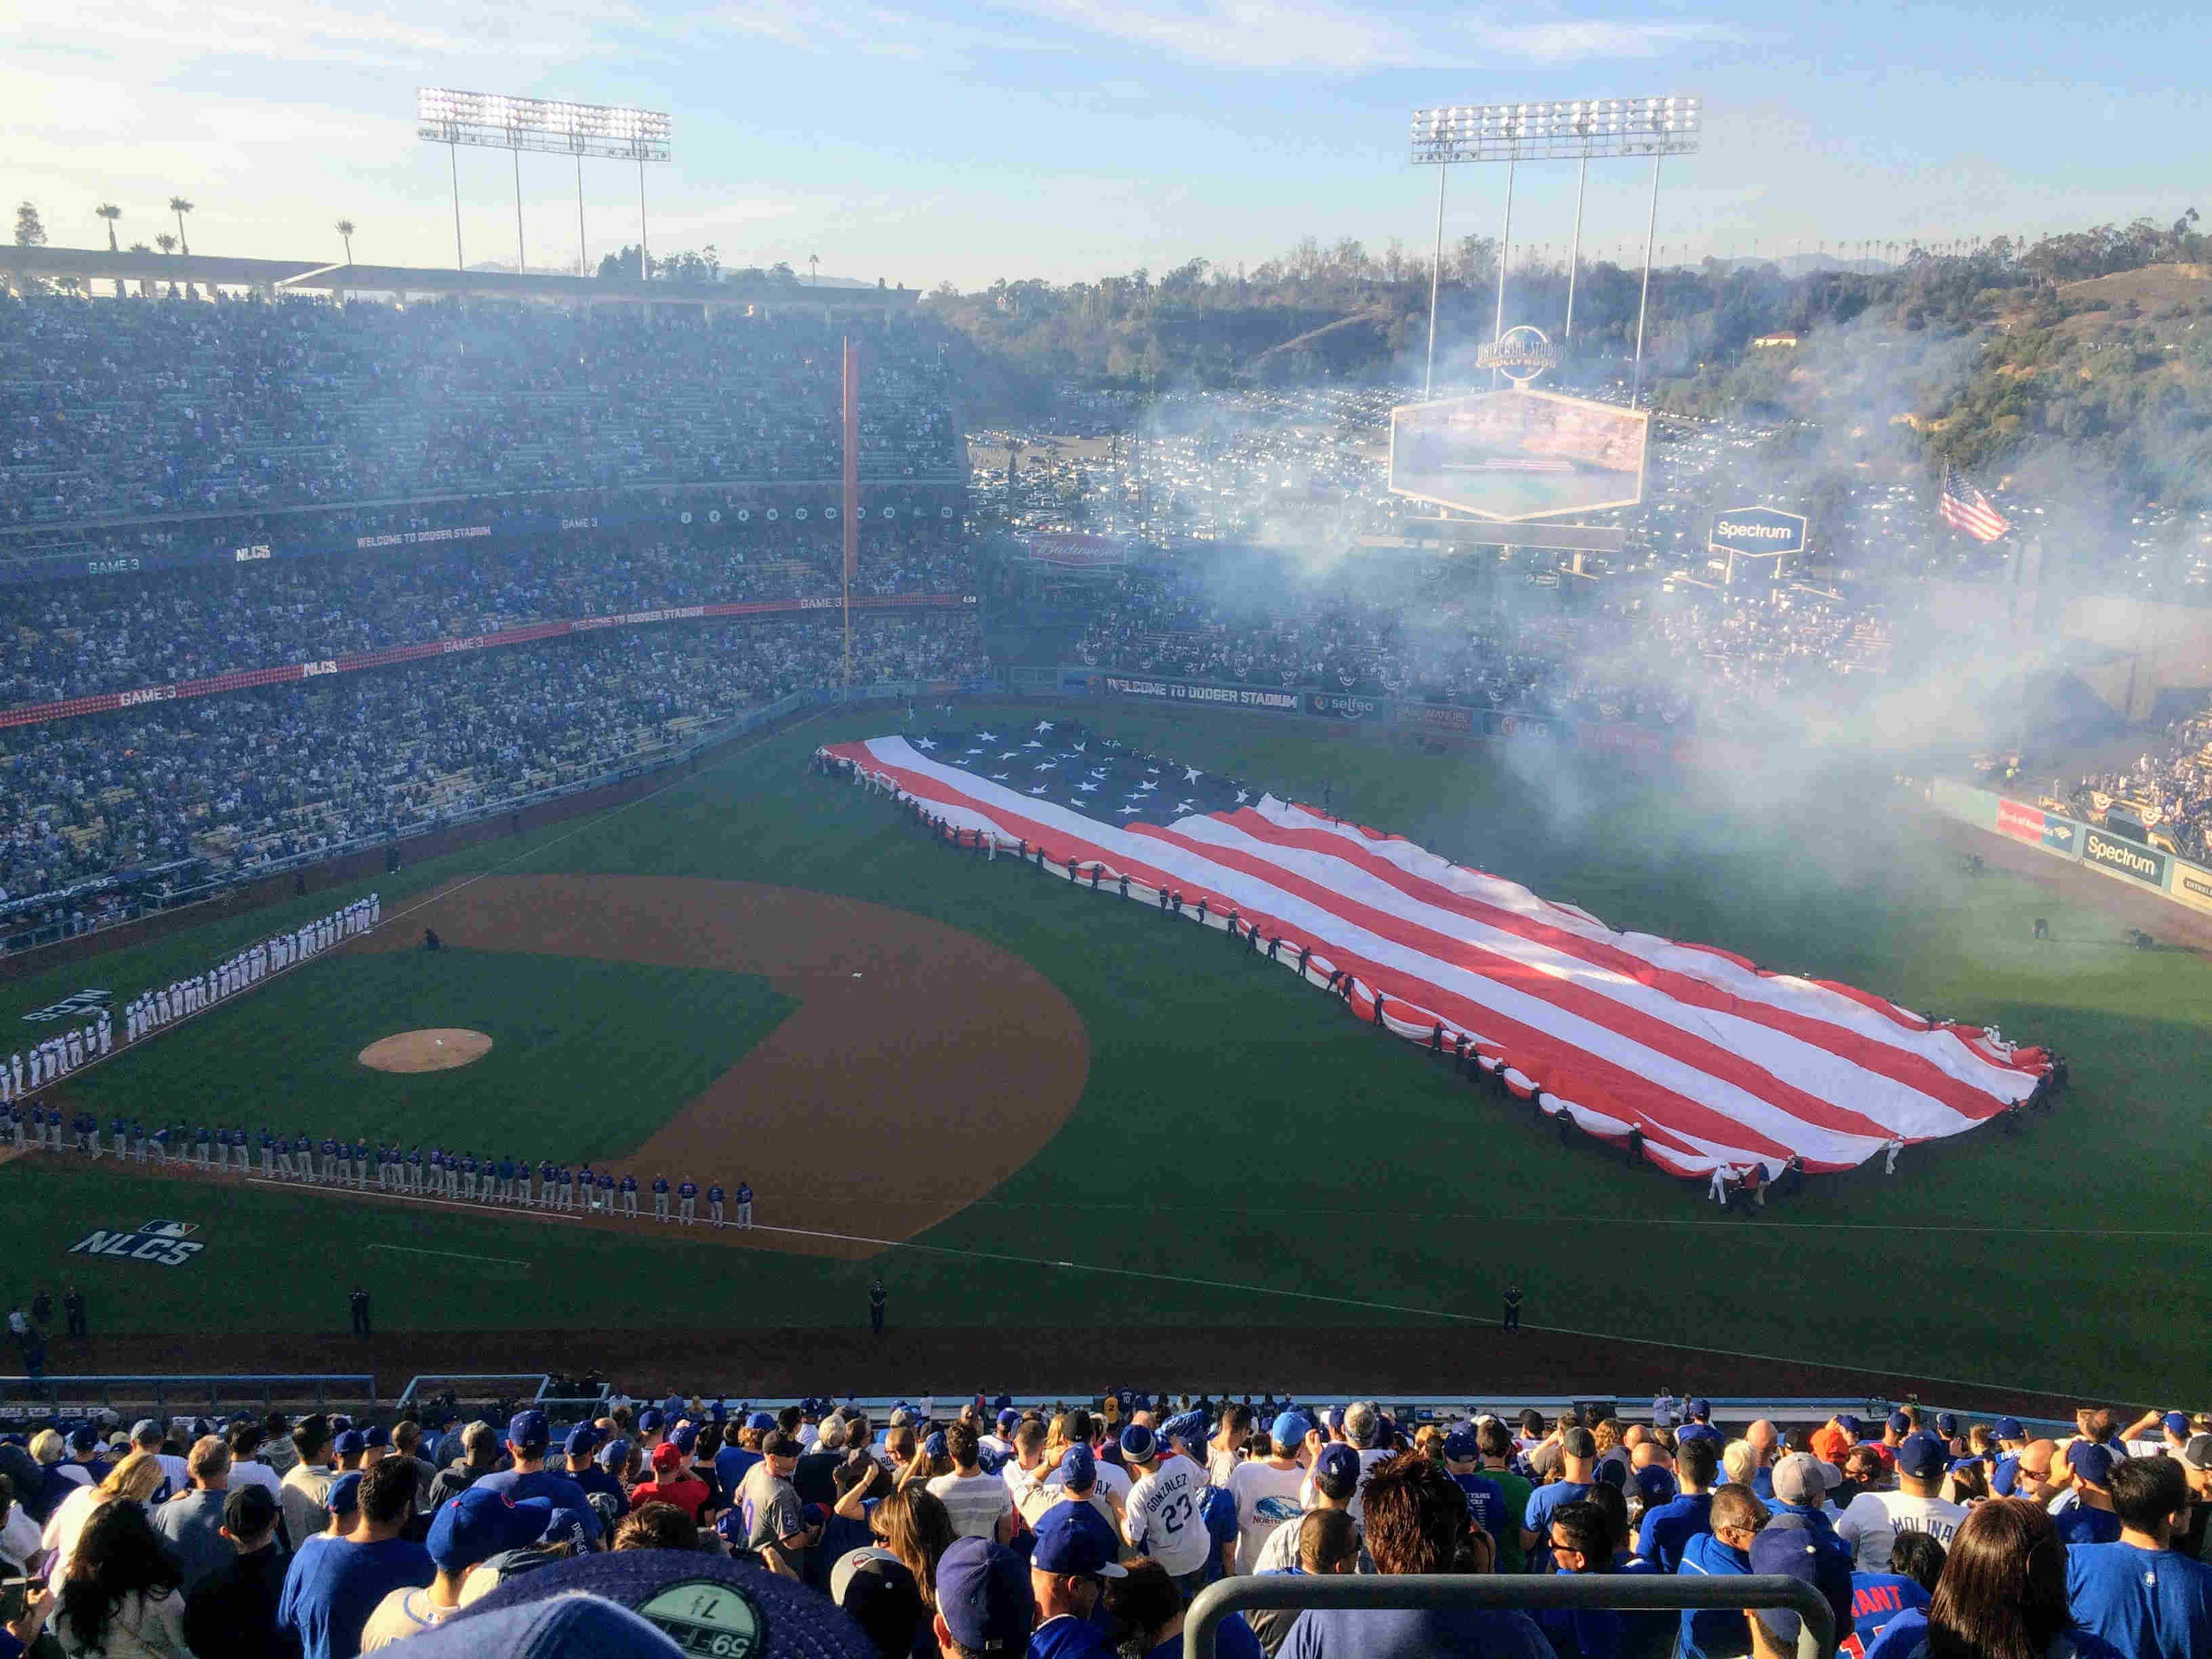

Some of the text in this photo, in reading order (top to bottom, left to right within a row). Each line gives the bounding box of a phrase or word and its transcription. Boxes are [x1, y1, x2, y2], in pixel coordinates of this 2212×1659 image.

[562, 517, 598, 529] GAME 3
[1719, 520, 1792, 539] Spectrum
[358, 533, 402, 548] WELCOME
[236, 544, 271, 561] NLCS
[89, 558, 140, 575] GAME 3
[801, 596, 842, 609] GAME 3
[445, 637, 483, 652] GAME 3
[304, 660, 337, 677] NLCS
[121, 685, 177, 706] GAME 3
[1107, 677, 1297, 708] WELCOME TO DODGER STADIUM
[2087, 835, 2156, 875] Spectrum
[67, 1231, 204, 1265] NLCS
[1147, 1473, 1188, 1513] GONZALEZ
[1161, 1493, 1193, 1534] 23
[1891, 1516, 1953, 1543] MOLINA
[1851, 1585, 1903, 1618] ANT
